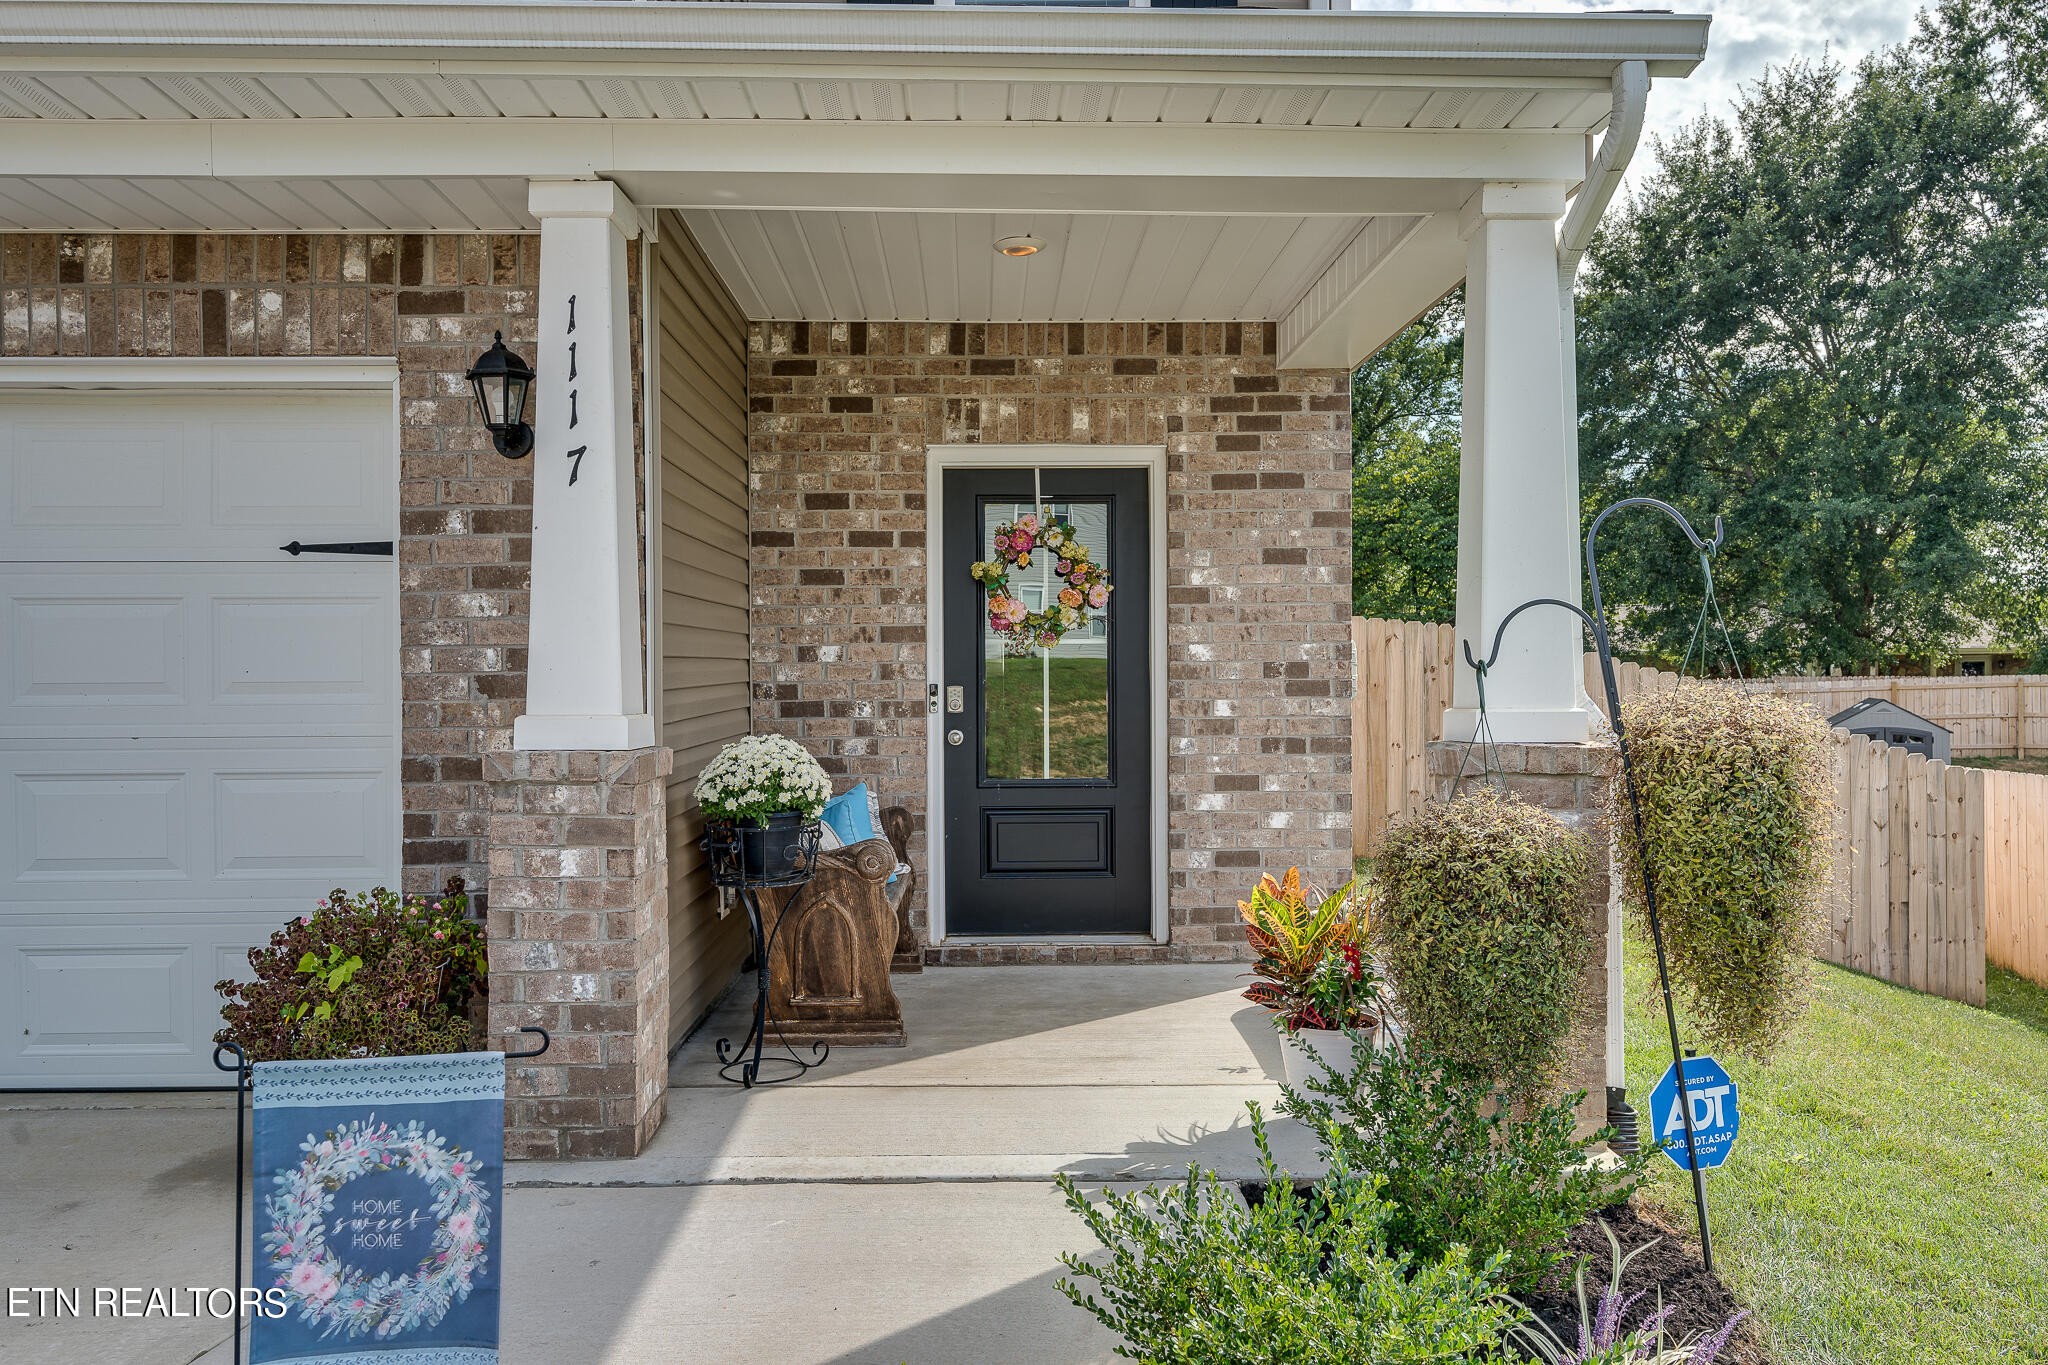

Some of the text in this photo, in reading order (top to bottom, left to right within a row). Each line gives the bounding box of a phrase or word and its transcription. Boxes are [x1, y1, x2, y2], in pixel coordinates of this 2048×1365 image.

[566, 294, 588, 487] 1117
[1674, 1075, 1714, 1087] SCURED BY
[1662, 1084, 1730, 1136] ADT
[1666, 1131, 1733, 1150] 00.DT.ASAP
[1686, 1146, 1717, 1157] T.COM
[352, 1199, 403, 1214] HOME
[331, 1208, 431, 1236] sweet
[352, 1233, 403, 1248] HOME
